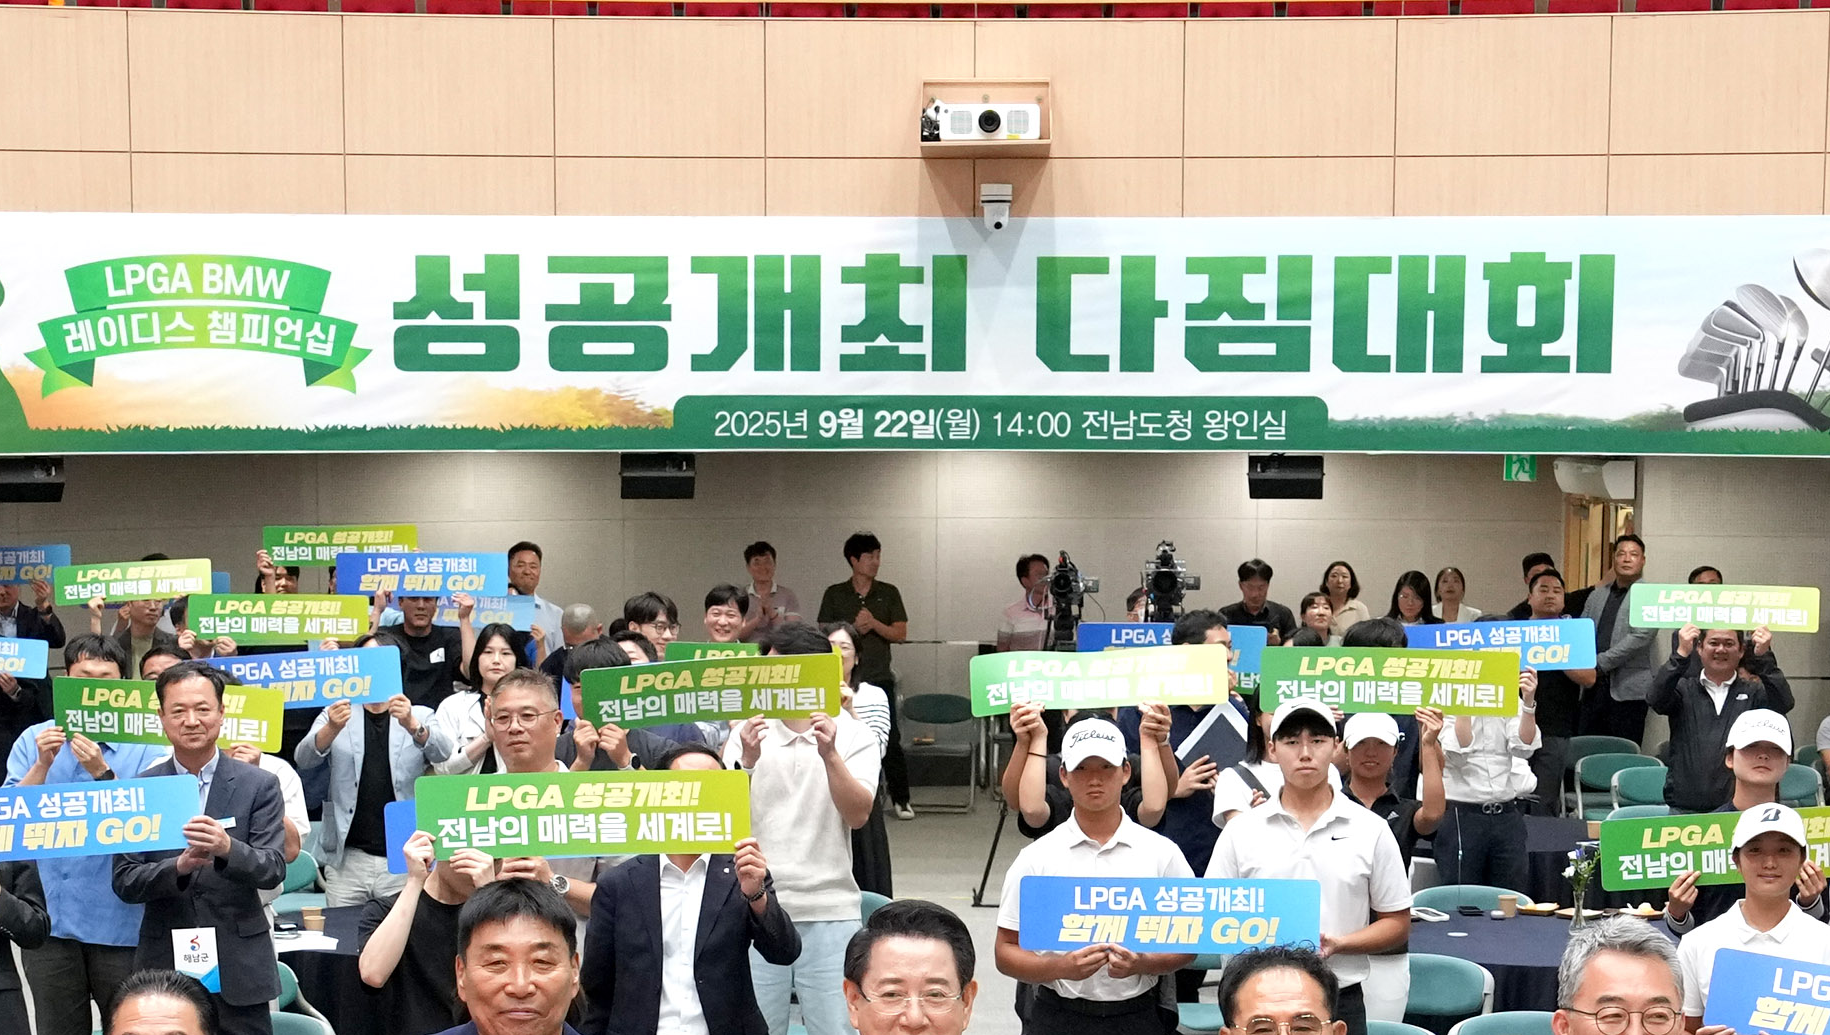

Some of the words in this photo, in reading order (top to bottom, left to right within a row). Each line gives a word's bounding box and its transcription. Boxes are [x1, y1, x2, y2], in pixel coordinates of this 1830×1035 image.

[106, 262, 196, 300] LPGA
[202, 270, 292, 301] BMW
[391, 252, 968, 374] 성공개최
[1034, 250, 1617, 376] 다짐대회
[62, 316, 196, 354] 레이디스
[207, 314, 337, 357] 챔피언십
[714, 411, 810, 443] 2025년
[819, 411, 865, 443] 9월
[873, 410, 981, 443] 22일(월)
[993, 411, 1071, 441] 14:00
[1080, 410, 1194, 443] 전남도청
[1201, 410, 1288, 443] 왕인실
[284, 531, 328, 544] LPGA
[332, 529, 394, 544] 성공개최!
[272, 545, 312, 561] 전남의
[368, 558, 410, 572] LPGA
[414, 556, 478, 572] 성공개최!
[19, 564, 52, 579] GO!
[77, 568, 122, 582] LPGA
[402, 575, 442, 591] 뛰자
[444, 574, 485, 591] GO!
[64, 582, 107, 599] 전남의
[109, 580, 153, 596] 매력을
[156, 577, 202, 594] 세계로!
[1658, 589, 1714, 604] LPGA
[214, 601, 268, 614] LPGA
[271, 600, 342, 615] 성공개최!
[1642, 606, 1692, 624] 전남의
[1696, 608, 1747, 625] 매력을
[1752, 608, 1808, 627] 세계로!
[198, 616, 247, 634] 전남의
[251, 616, 300, 634] 매력을
[305, 616, 358, 635] 세계로!
[1436, 630, 1485, 647] LPGA
[1489, 625, 1561, 645] 성공개최!
[619, 672, 694, 694] LPGA
[701, 663, 800, 687] 성공개최!
[1006, 659, 1081, 678] LPGA
[1298, 656, 1373, 676] LPGA
[1382, 657, 1483, 680] 성공개최!
[598, 694, 668, 722] 전남의
[674, 689, 745, 716] 매력을
[749, 685, 826, 714] 세계로!
[986, 680, 1054, 704] 전남의
[1352, 681, 1424, 705] 매력을
[1428, 683, 1504, 709] 세계로!
[65, 709, 120, 735] 전남의
[37, 787, 146, 818] 성공개최!
[465, 785, 566, 811] LPGA
[573, 781, 703, 808] 성공개최!
[22, 820, 90, 850] 뛰자
[95, 815, 162, 844] GO!
[437, 815, 529, 847] 전남의
[538, 811, 628, 844] 매력을
[636, 810, 733, 843] 세계로!
[1074, 886, 1147, 911] LPGA
[1154, 885, 1265, 914] 성공개최!
[1058, 917, 1127, 943] 함께
[1133, 917, 1204, 944] 뛰자
[1210, 917, 1279, 944] GO!
[183, 952, 209, 963] 해남군
